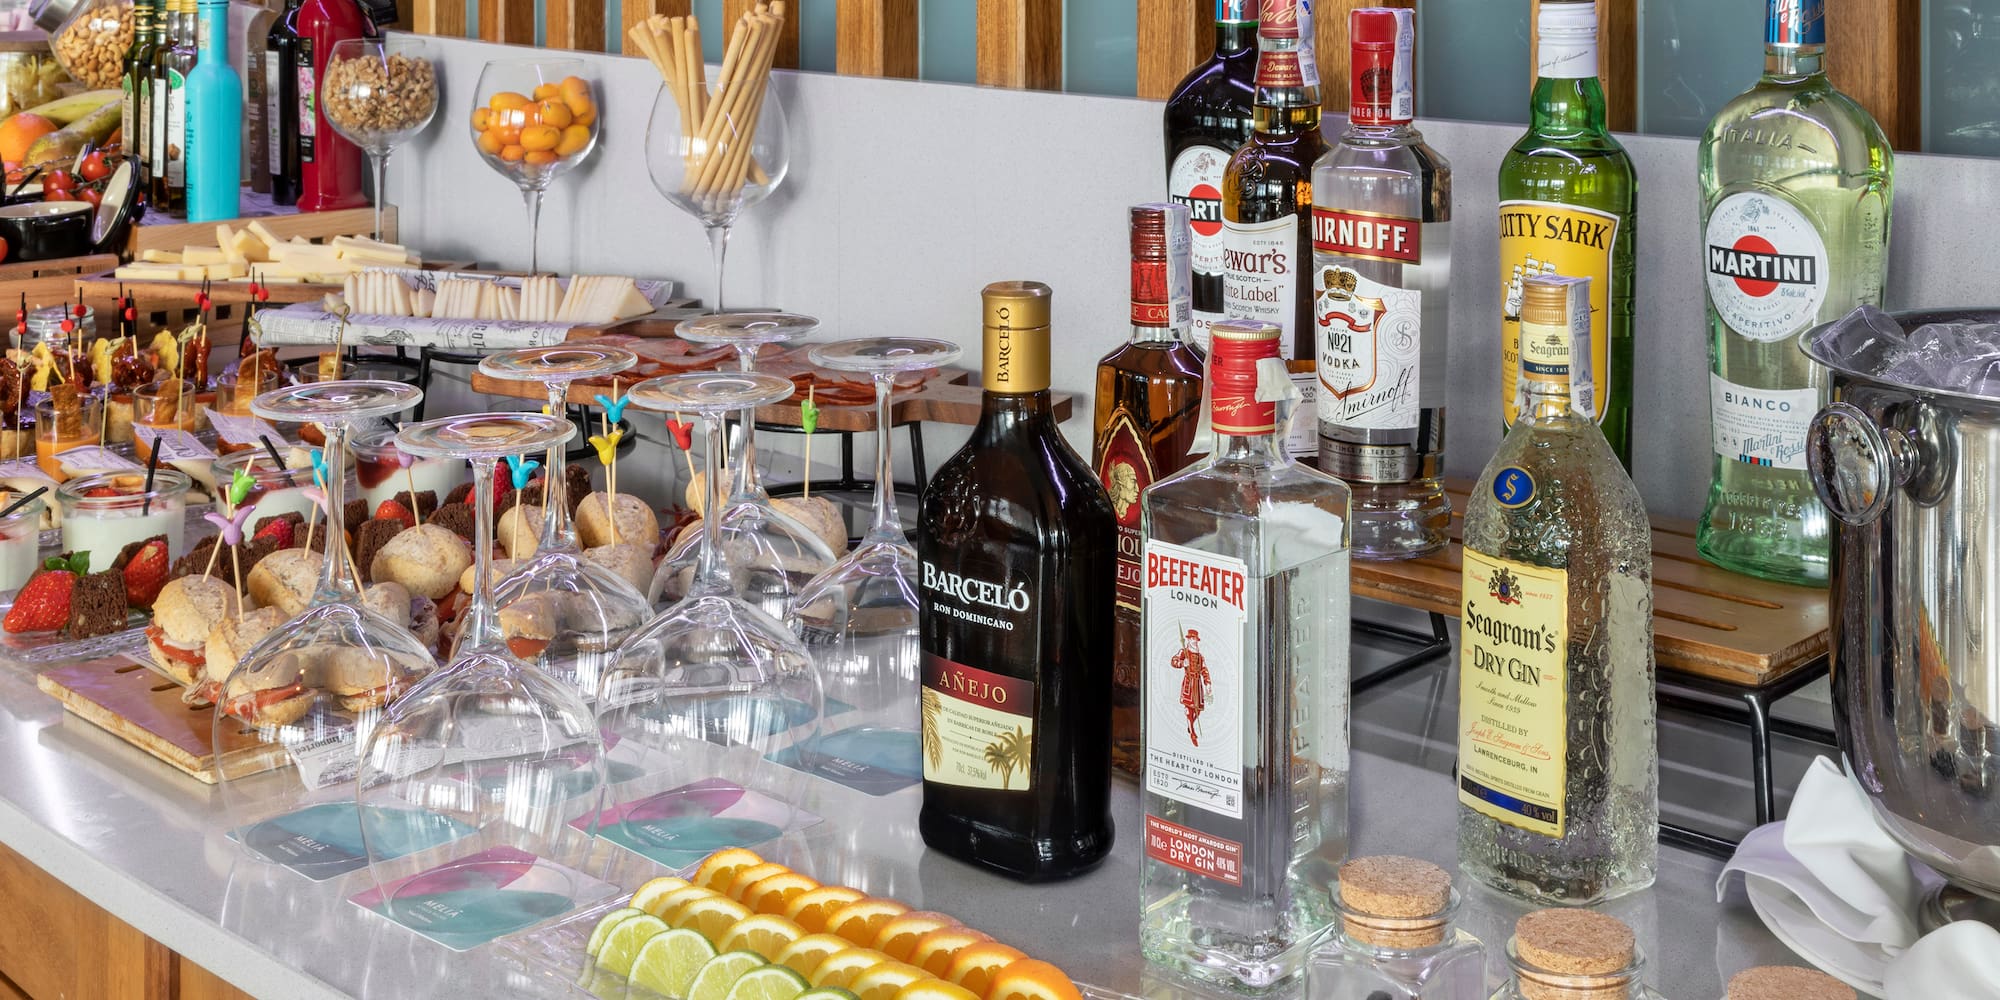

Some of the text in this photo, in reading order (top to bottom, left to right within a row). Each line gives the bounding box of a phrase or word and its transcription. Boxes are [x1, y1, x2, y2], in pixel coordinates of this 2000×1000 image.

[1500, 213, 1610, 250] UTTY SARK
[1224, 248, 1287, 275] ewar's
[1711, 248, 1812, 282] MARTINI
[1236, 275, 1262, 283] SCOTCH
[996, 307, 1012, 383] BARCELÓ
[1322, 351, 1361, 370] VODKA
[1335, 365, 1416, 423] Smirnoff
[1725, 391, 1791, 412] BIANCO
[922, 561, 1030, 612] BARCELÓ
[1148, 552, 1244, 611] BEEFEATER
[1170, 590, 1218, 610] LONDON
[933, 602, 1014, 631] RON DOMINICANO
[1466, 600, 1556, 653] Seagram's
[1474, 644, 1541, 687] DRY GIN
[939, 671, 1007, 704] AÑEJO
[1481, 715, 1529, 737] DISTILLED BY
[1150, 753, 1239, 785] THE HEART OF LONDON
[1530, 764, 1538, 774] IN
[1150, 820, 1160, 829] THE
[1170, 837, 1215, 860] LONDON
[1170, 849, 1215, 871] DRY GIN
